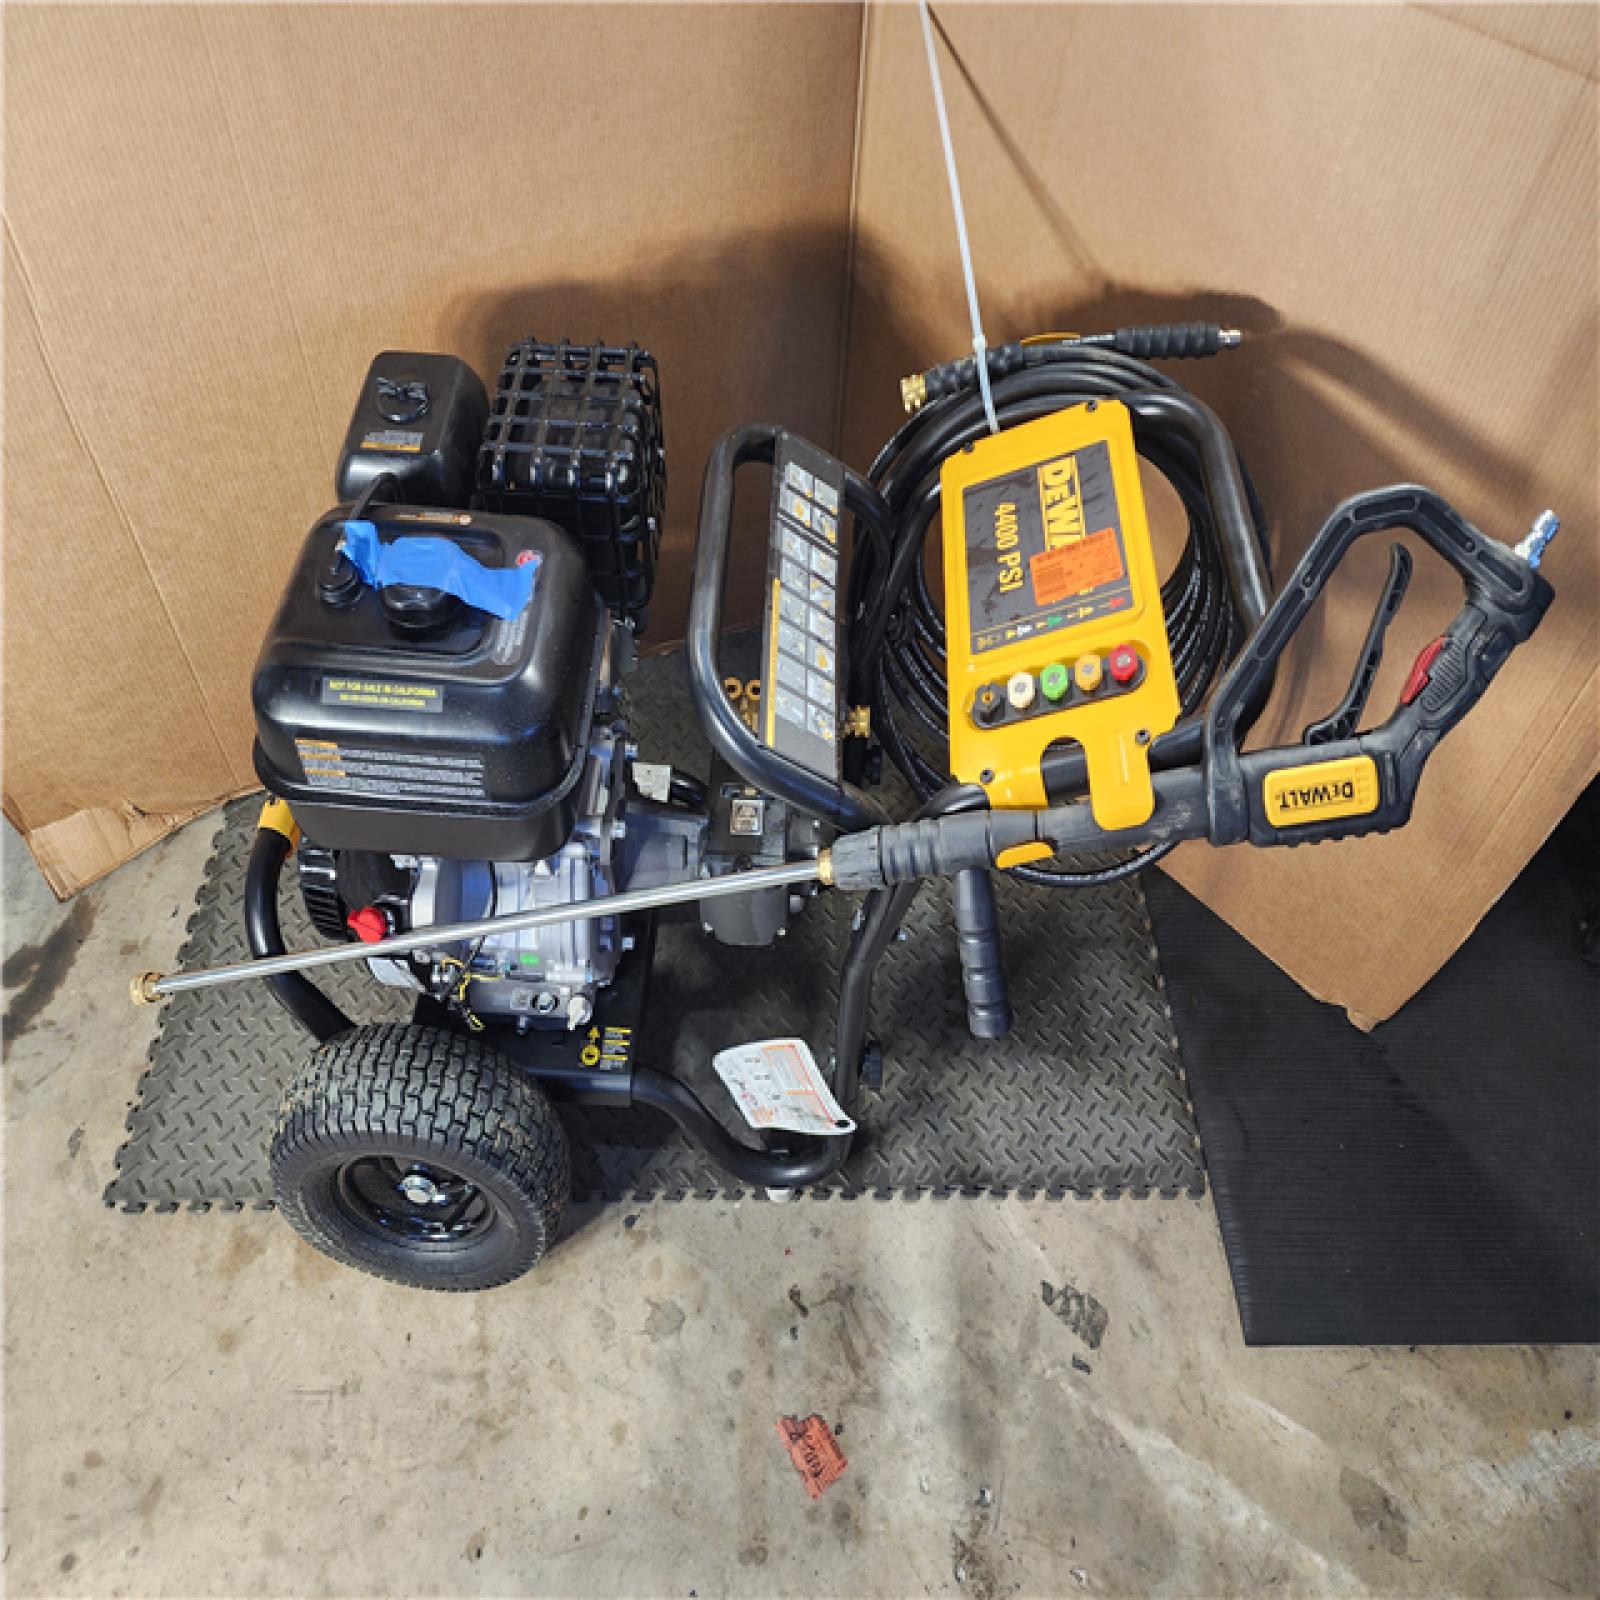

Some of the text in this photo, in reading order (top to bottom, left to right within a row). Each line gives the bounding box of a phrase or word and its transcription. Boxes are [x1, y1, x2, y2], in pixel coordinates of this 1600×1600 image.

[994, 502, 1024, 592] 4400 PSI
[1040, 456, 1084, 552] DEWA
